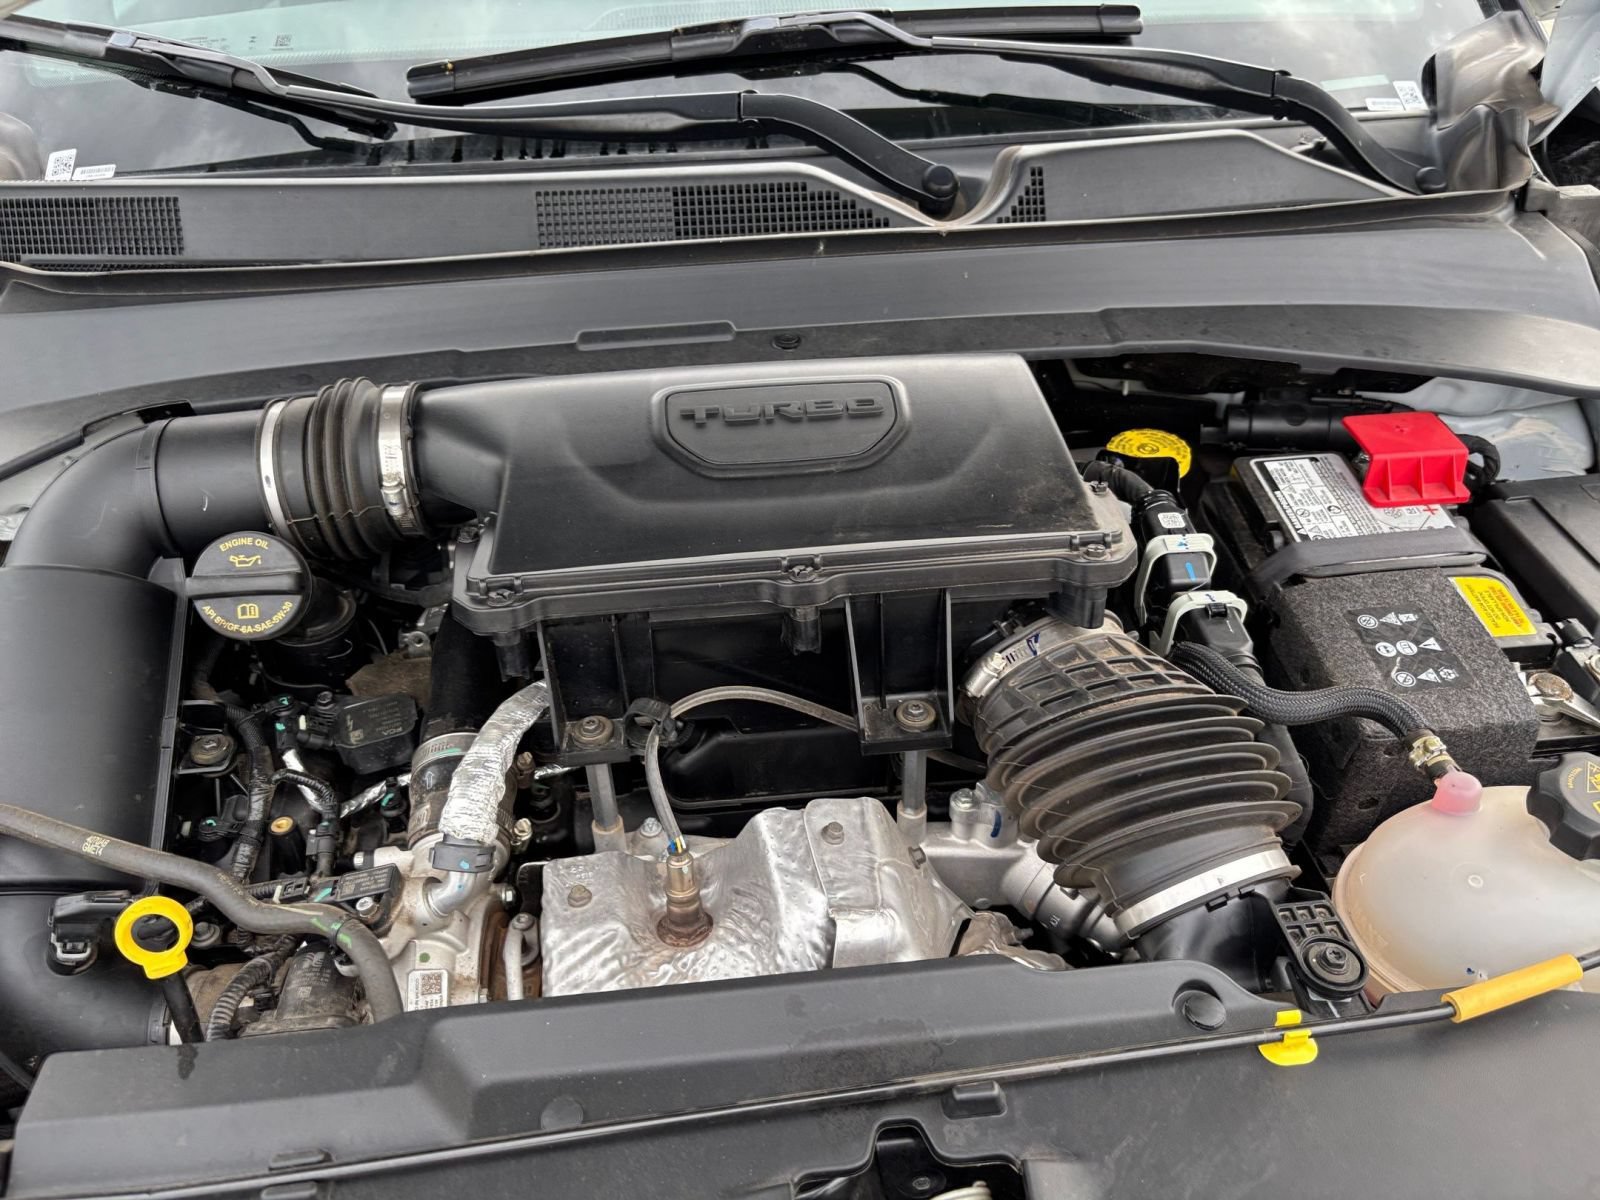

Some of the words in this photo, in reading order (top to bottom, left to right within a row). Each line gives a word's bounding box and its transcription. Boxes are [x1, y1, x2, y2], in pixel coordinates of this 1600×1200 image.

[680, 398, 884, 426] TURBO
[219, 537, 254, 552] ENGINE
[255, 538, 269, 550] OIL
[202, 605, 215, 618] API
